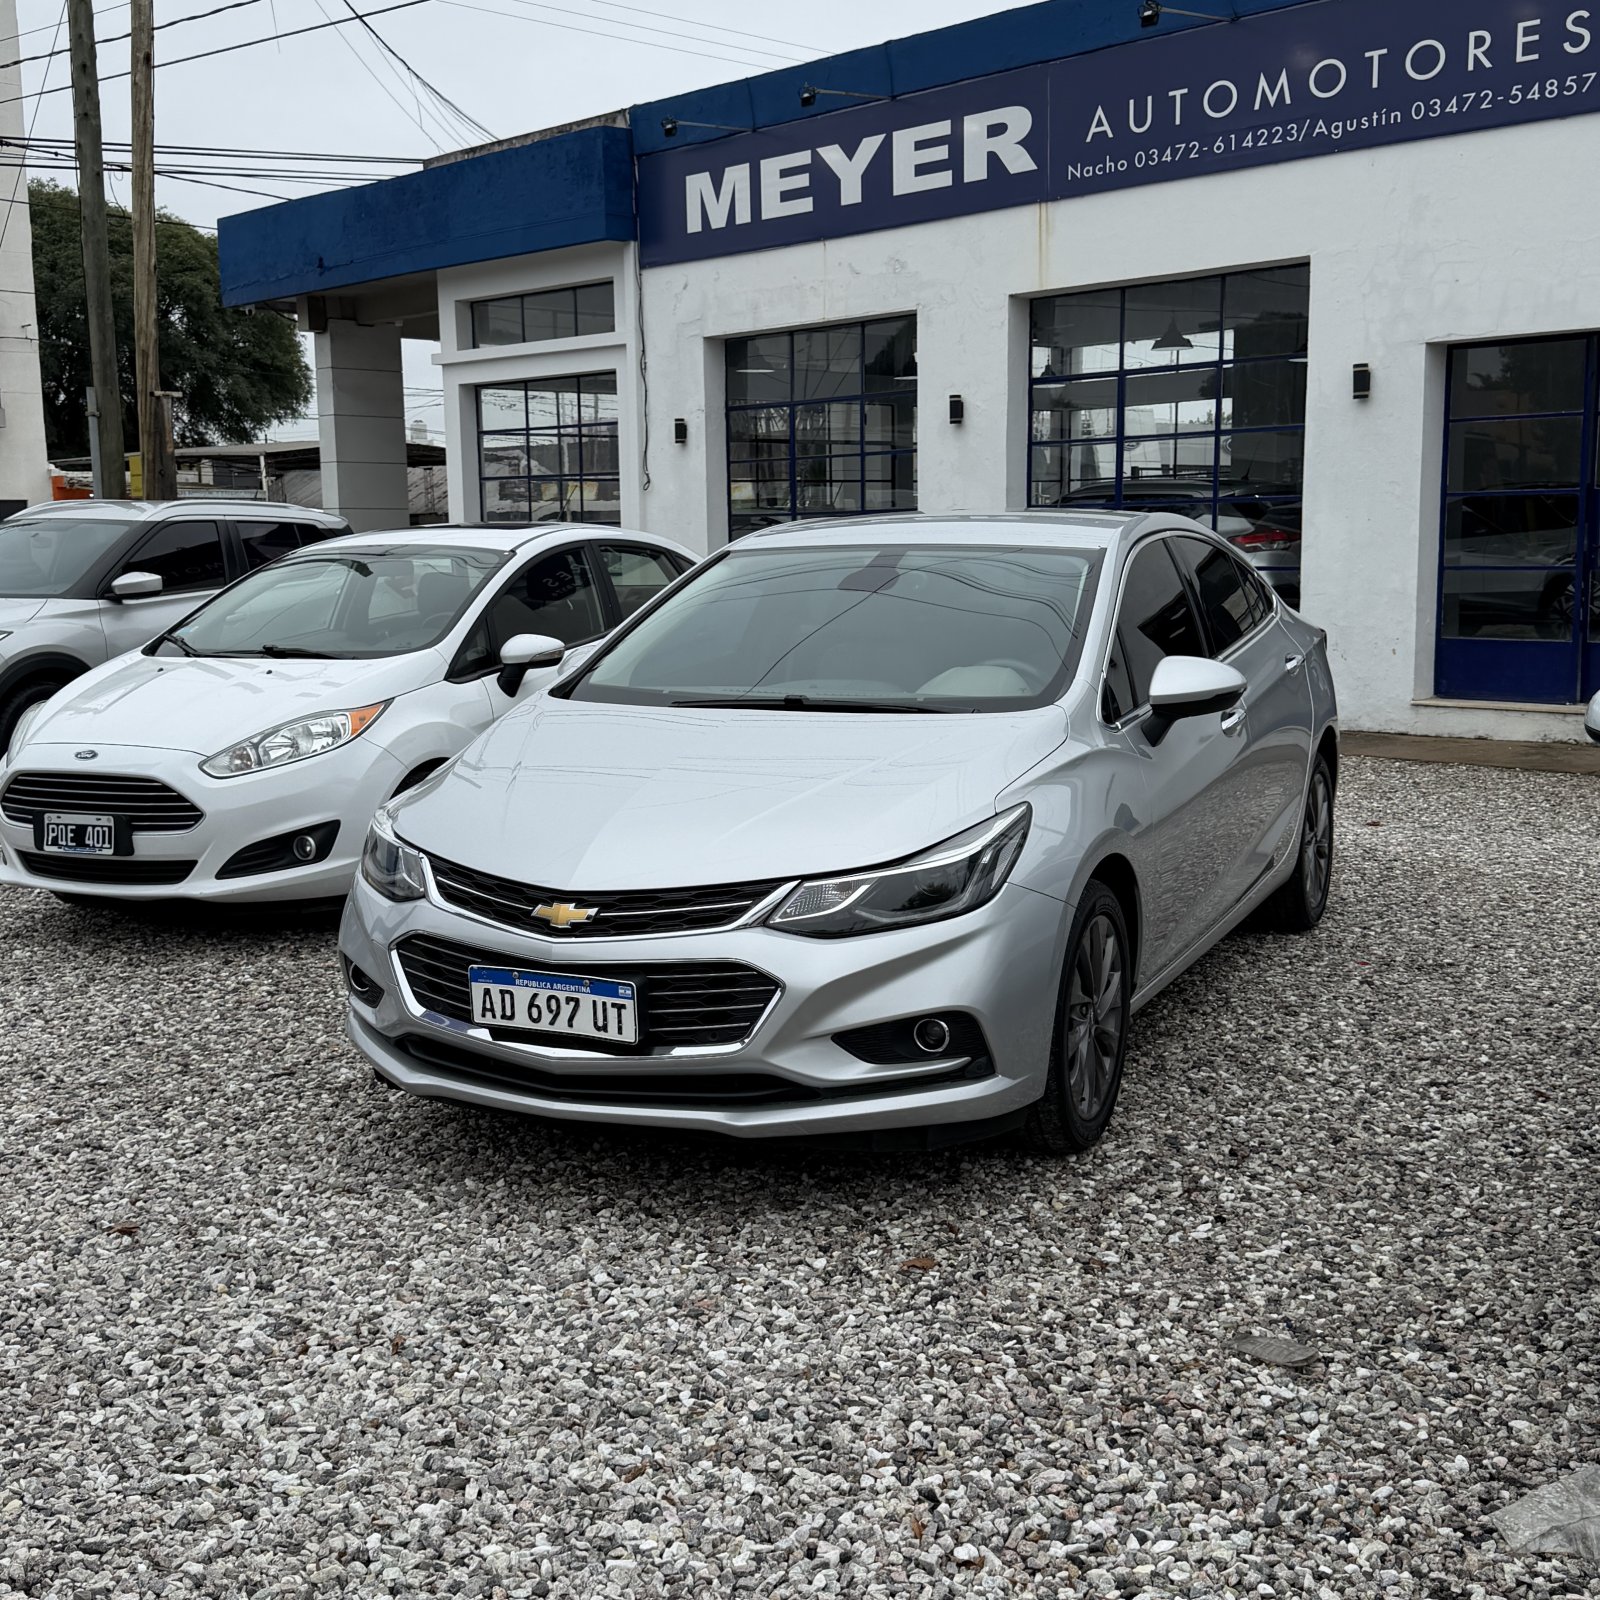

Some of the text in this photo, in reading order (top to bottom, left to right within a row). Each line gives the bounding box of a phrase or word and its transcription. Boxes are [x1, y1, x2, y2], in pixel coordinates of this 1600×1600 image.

[1085, 9, 1592, 143] AUTOMOTORES
[685, 105, 1038, 234] MEYER
[1067, 155, 1128, 181] Nacho
[85, 826, 111, 848] 401
[515, 979, 591, 994] REPUBLICA ARGENTINA
[480, 987, 627, 1036] AD 697 UT
